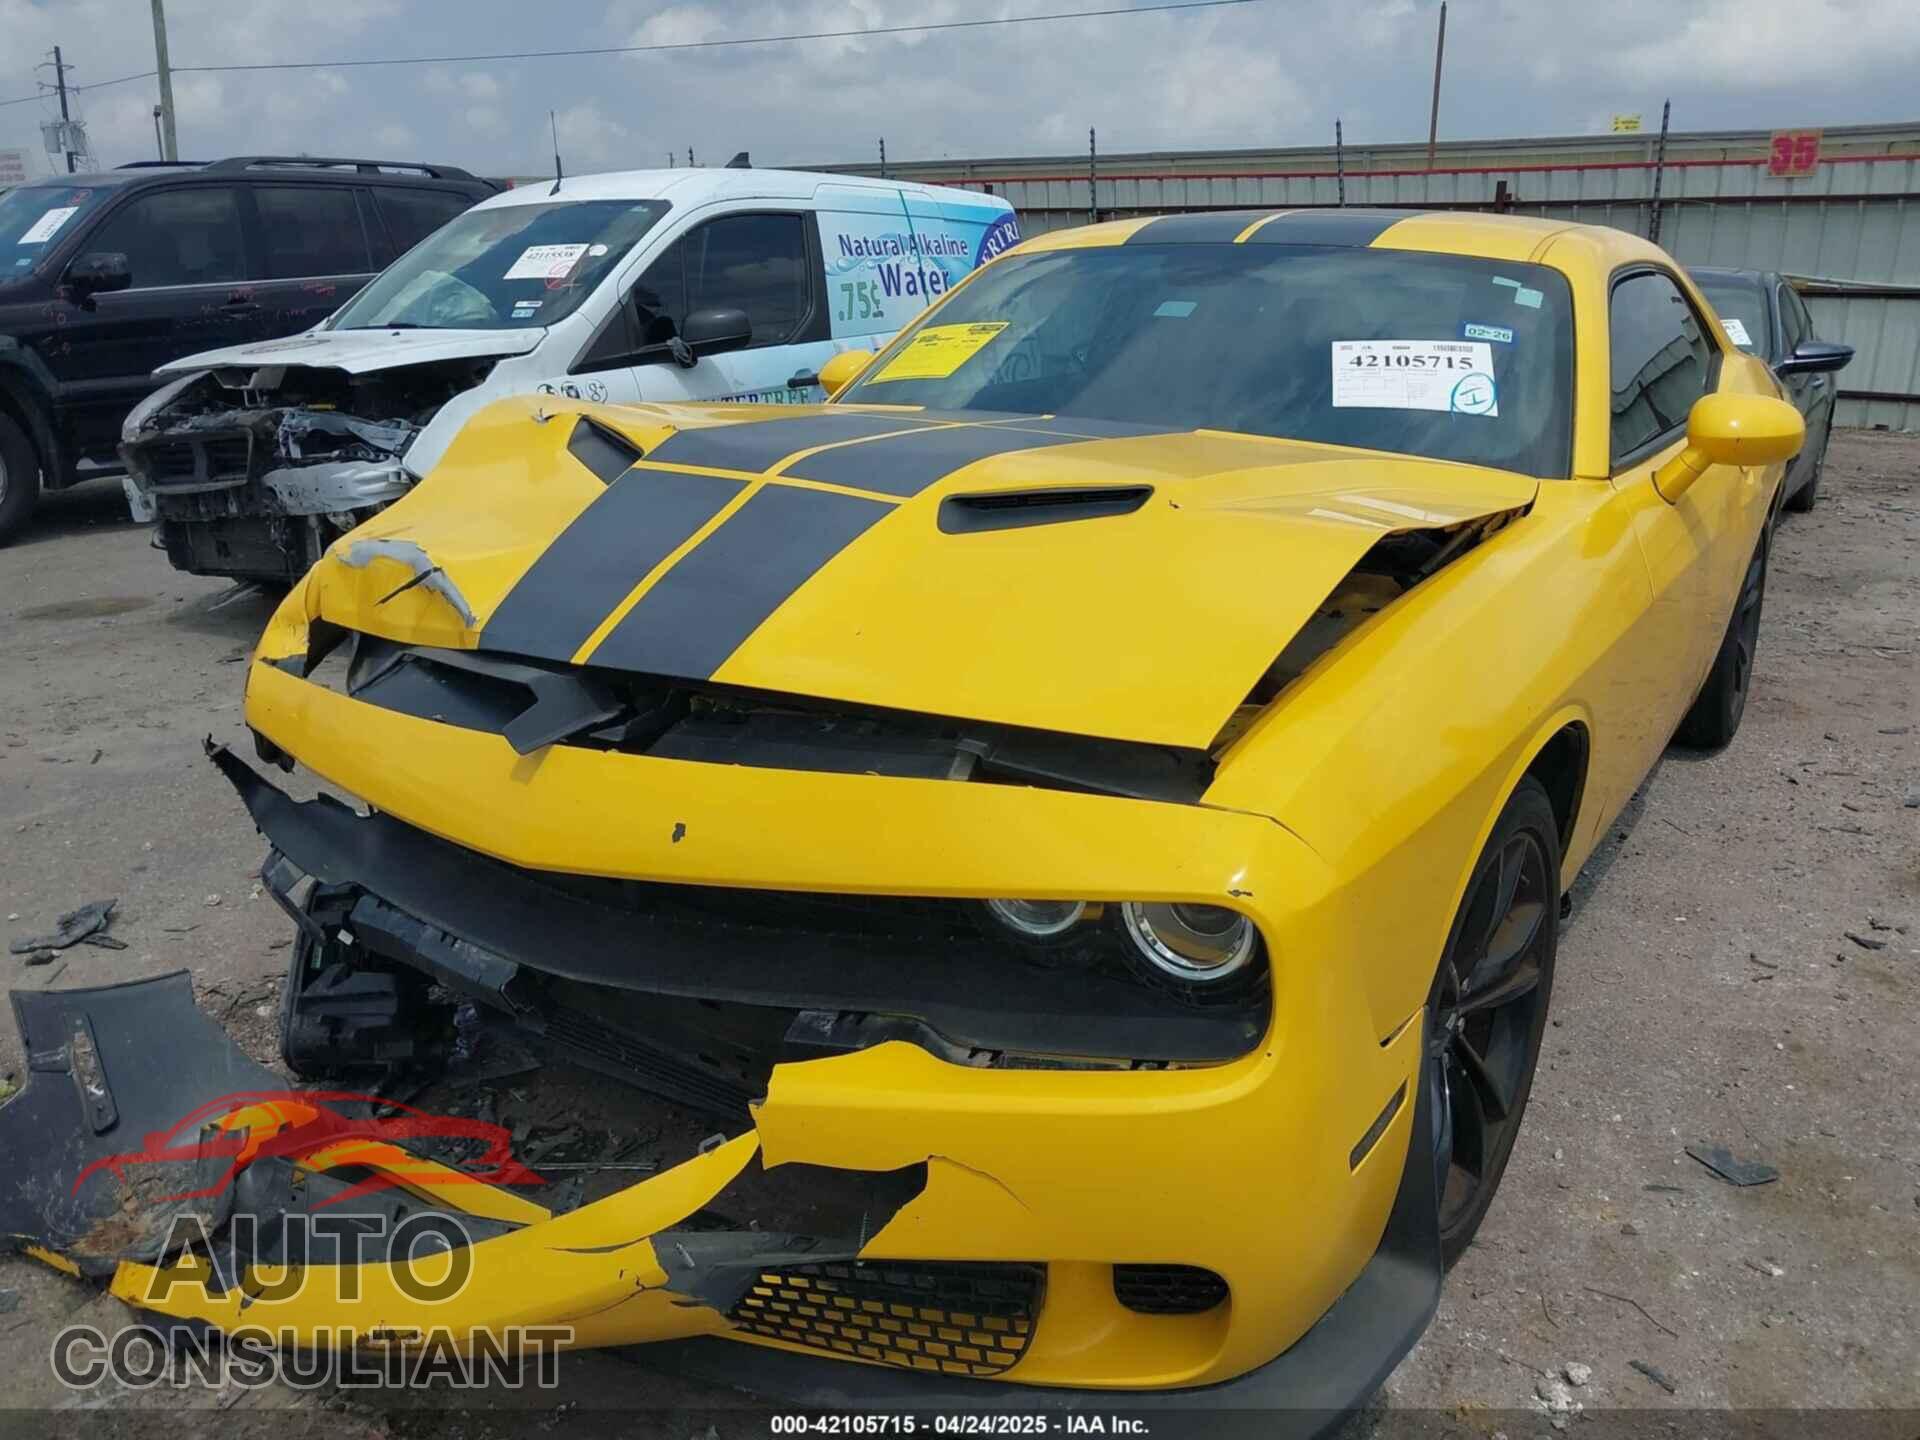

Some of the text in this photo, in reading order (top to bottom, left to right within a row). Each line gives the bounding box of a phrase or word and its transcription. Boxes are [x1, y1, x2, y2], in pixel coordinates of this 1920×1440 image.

[1770, 136, 1819, 171] 35
[838, 233, 969, 257] Natural Alkaline
[878, 263, 949, 297] Water
[1467, 327, 1511, 341] 02-26
[1349, 354, 1473, 370] 42105715
